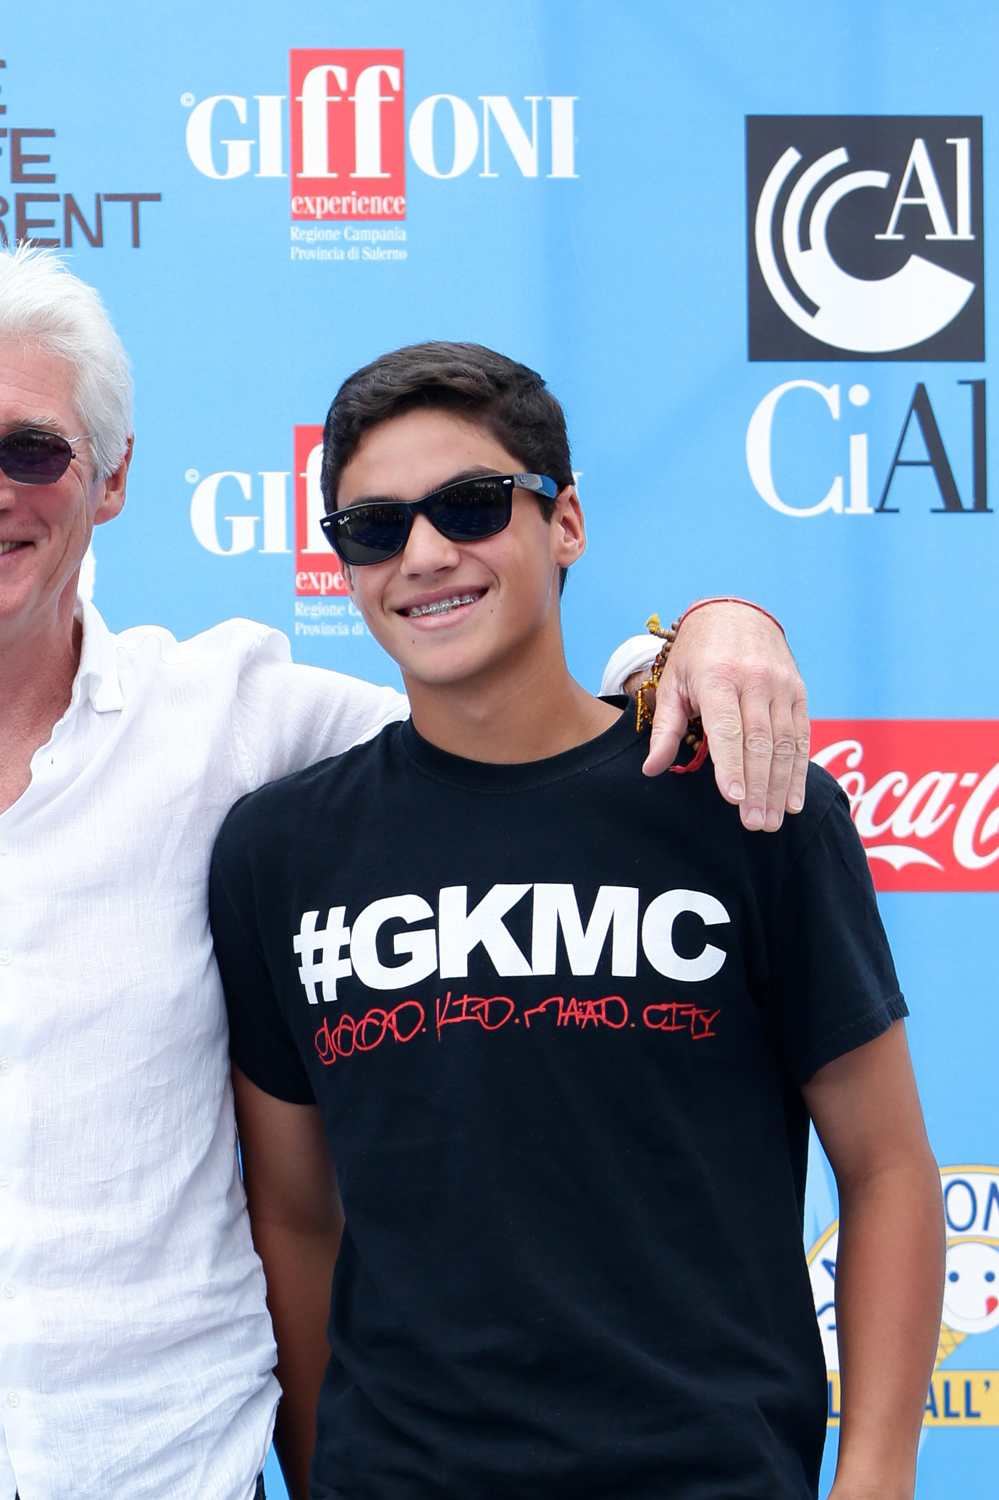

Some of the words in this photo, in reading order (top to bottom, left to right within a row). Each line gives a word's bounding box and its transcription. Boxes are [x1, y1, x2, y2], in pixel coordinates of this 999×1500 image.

[291, 191, 406, 220] experience
[290, 226, 341, 243] Regione
[343, 226, 407, 244] Campania
[290, 246, 344, 260] Provincia
[347, 246, 360, 260] di
[362, 246, 409, 260] Salerno
[294, 601, 346, 619] Regione
[294, 622, 349, 636] Provincia
[293, 883, 731, 1004] #GKMC
